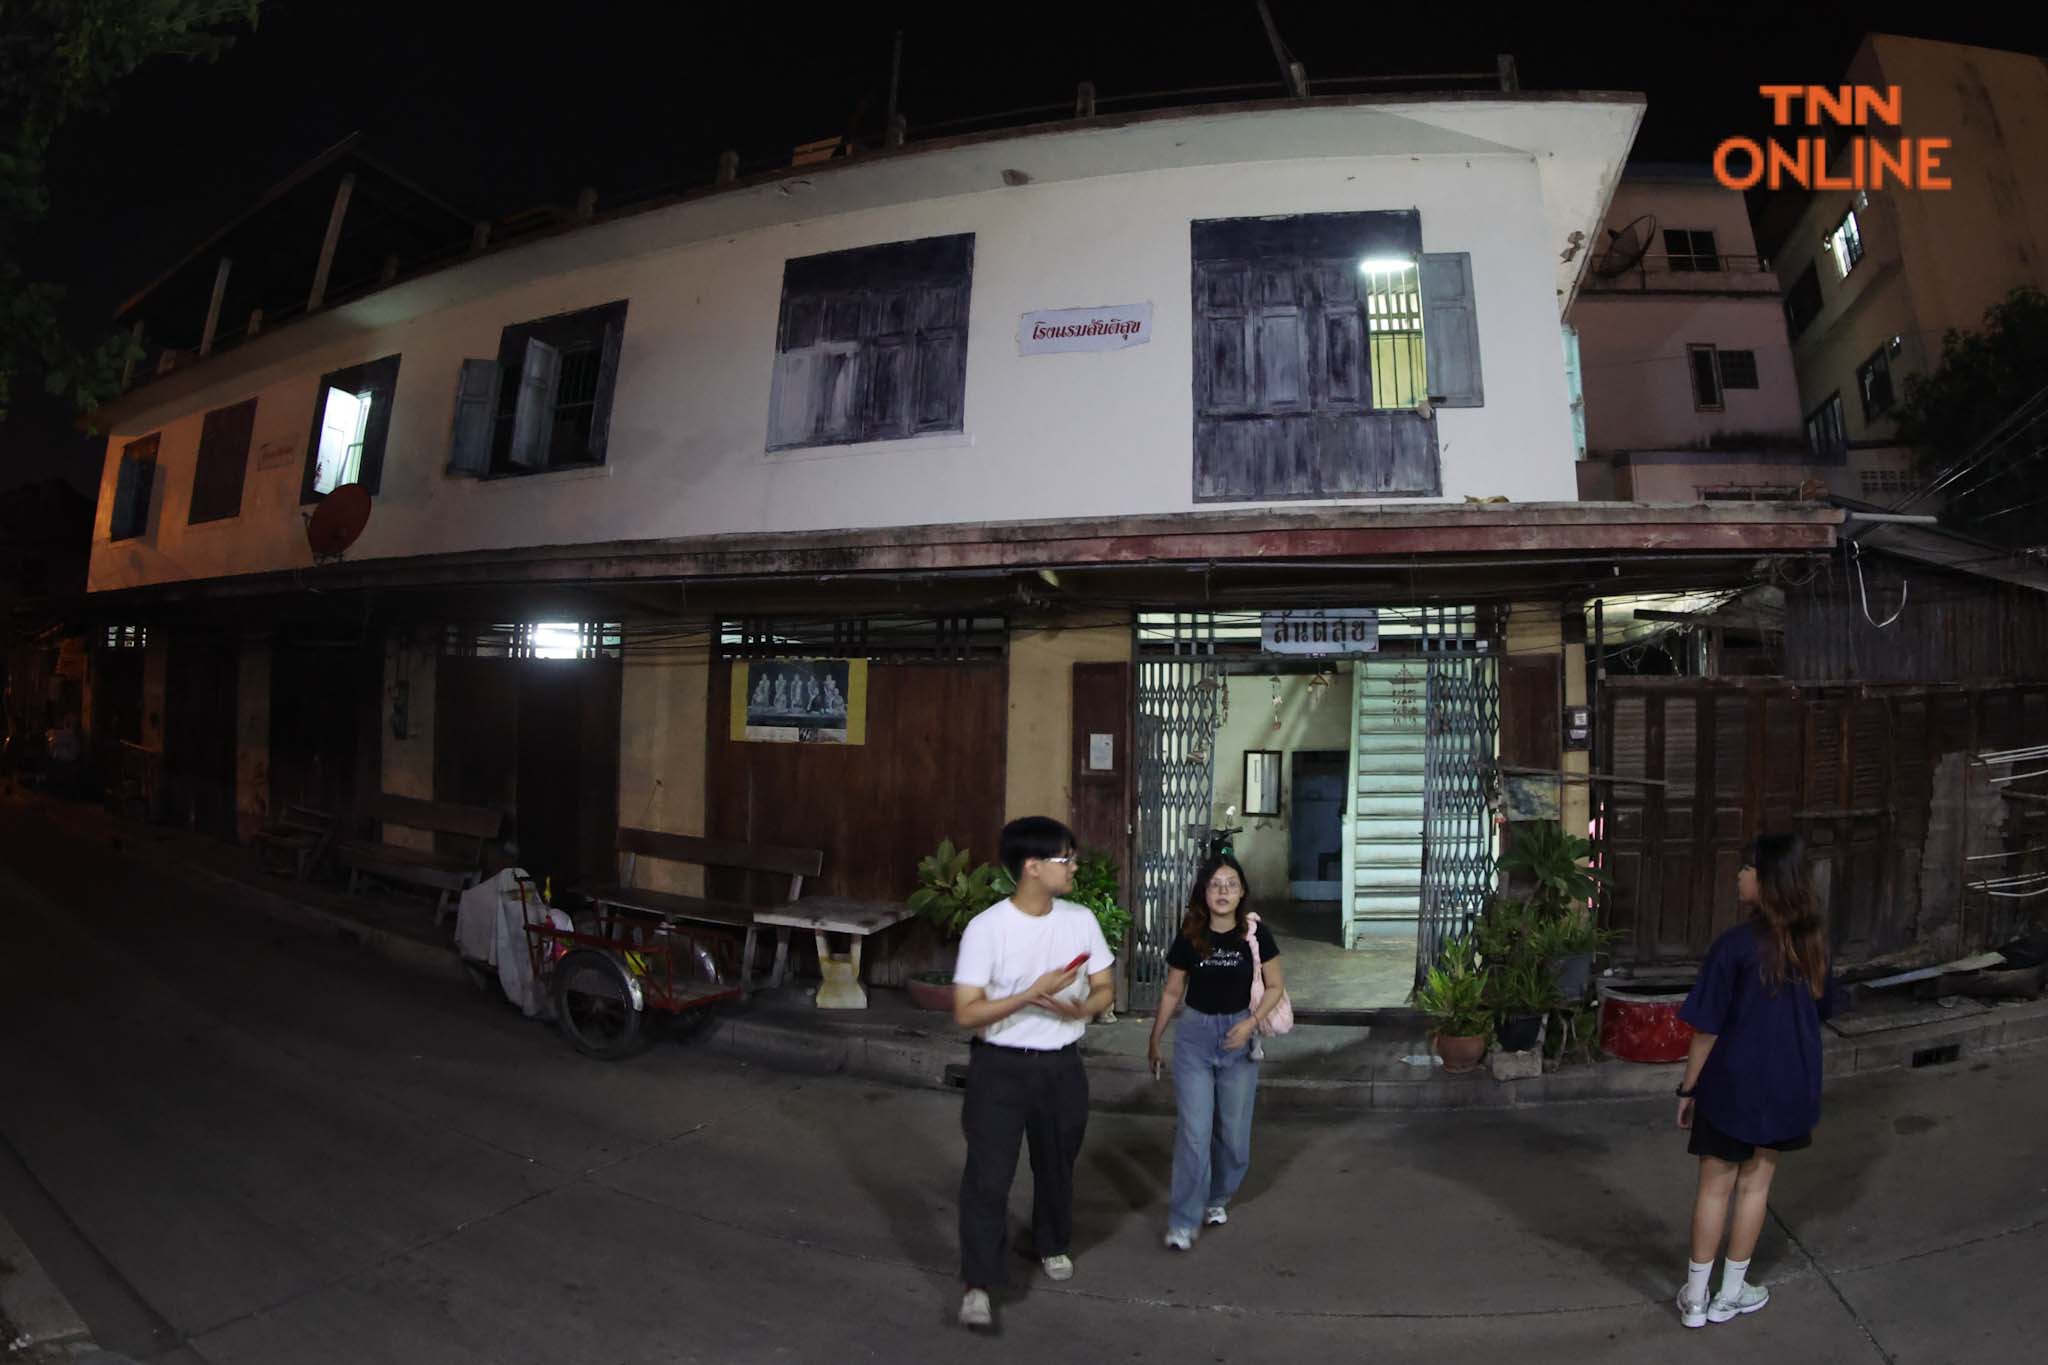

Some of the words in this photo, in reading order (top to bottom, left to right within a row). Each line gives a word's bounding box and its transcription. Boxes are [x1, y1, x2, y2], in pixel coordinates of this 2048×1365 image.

[1032, 318, 1141, 341] โรงแรมสันติสุข
[1273, 608, 1366, 651] สันติสุข
